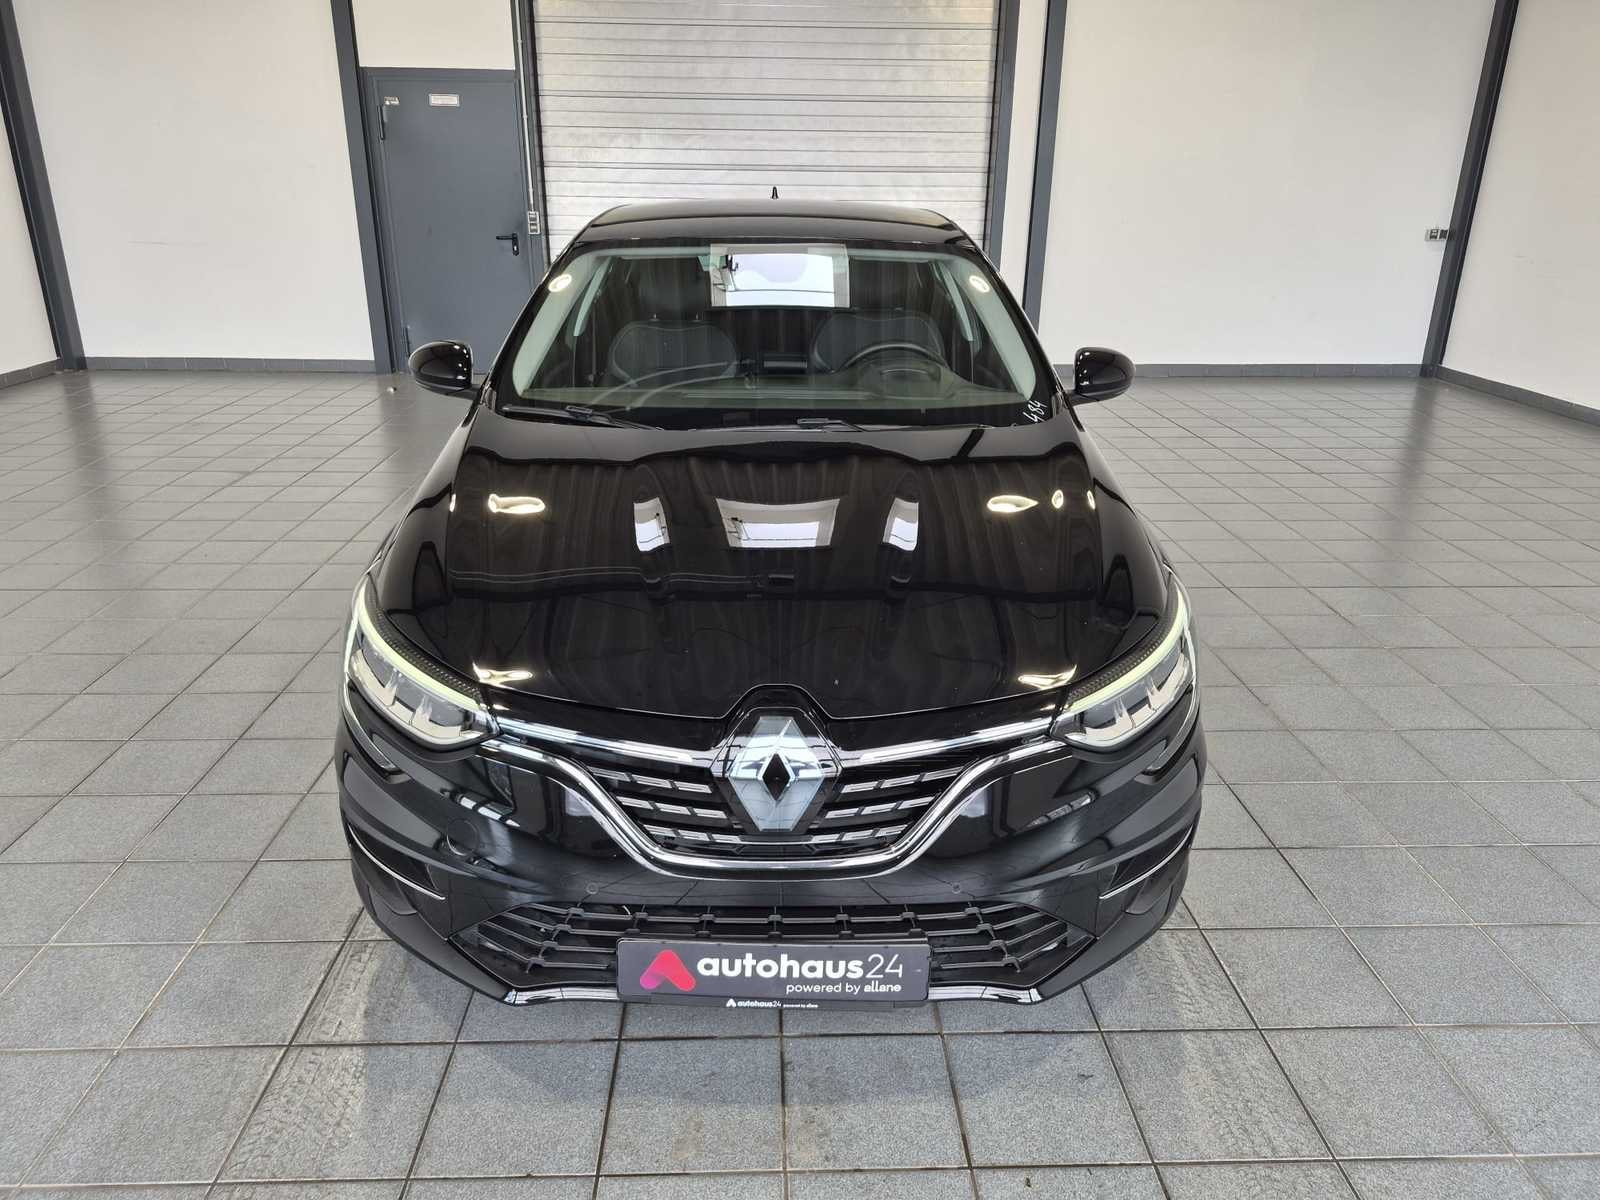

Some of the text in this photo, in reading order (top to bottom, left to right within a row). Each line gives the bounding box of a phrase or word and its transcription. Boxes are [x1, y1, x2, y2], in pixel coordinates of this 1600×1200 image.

[1022, 400, 1047, 422] 484
[697, 952, 903, 979] autohaus24
[786, 981, 902, 995] powered by allane
